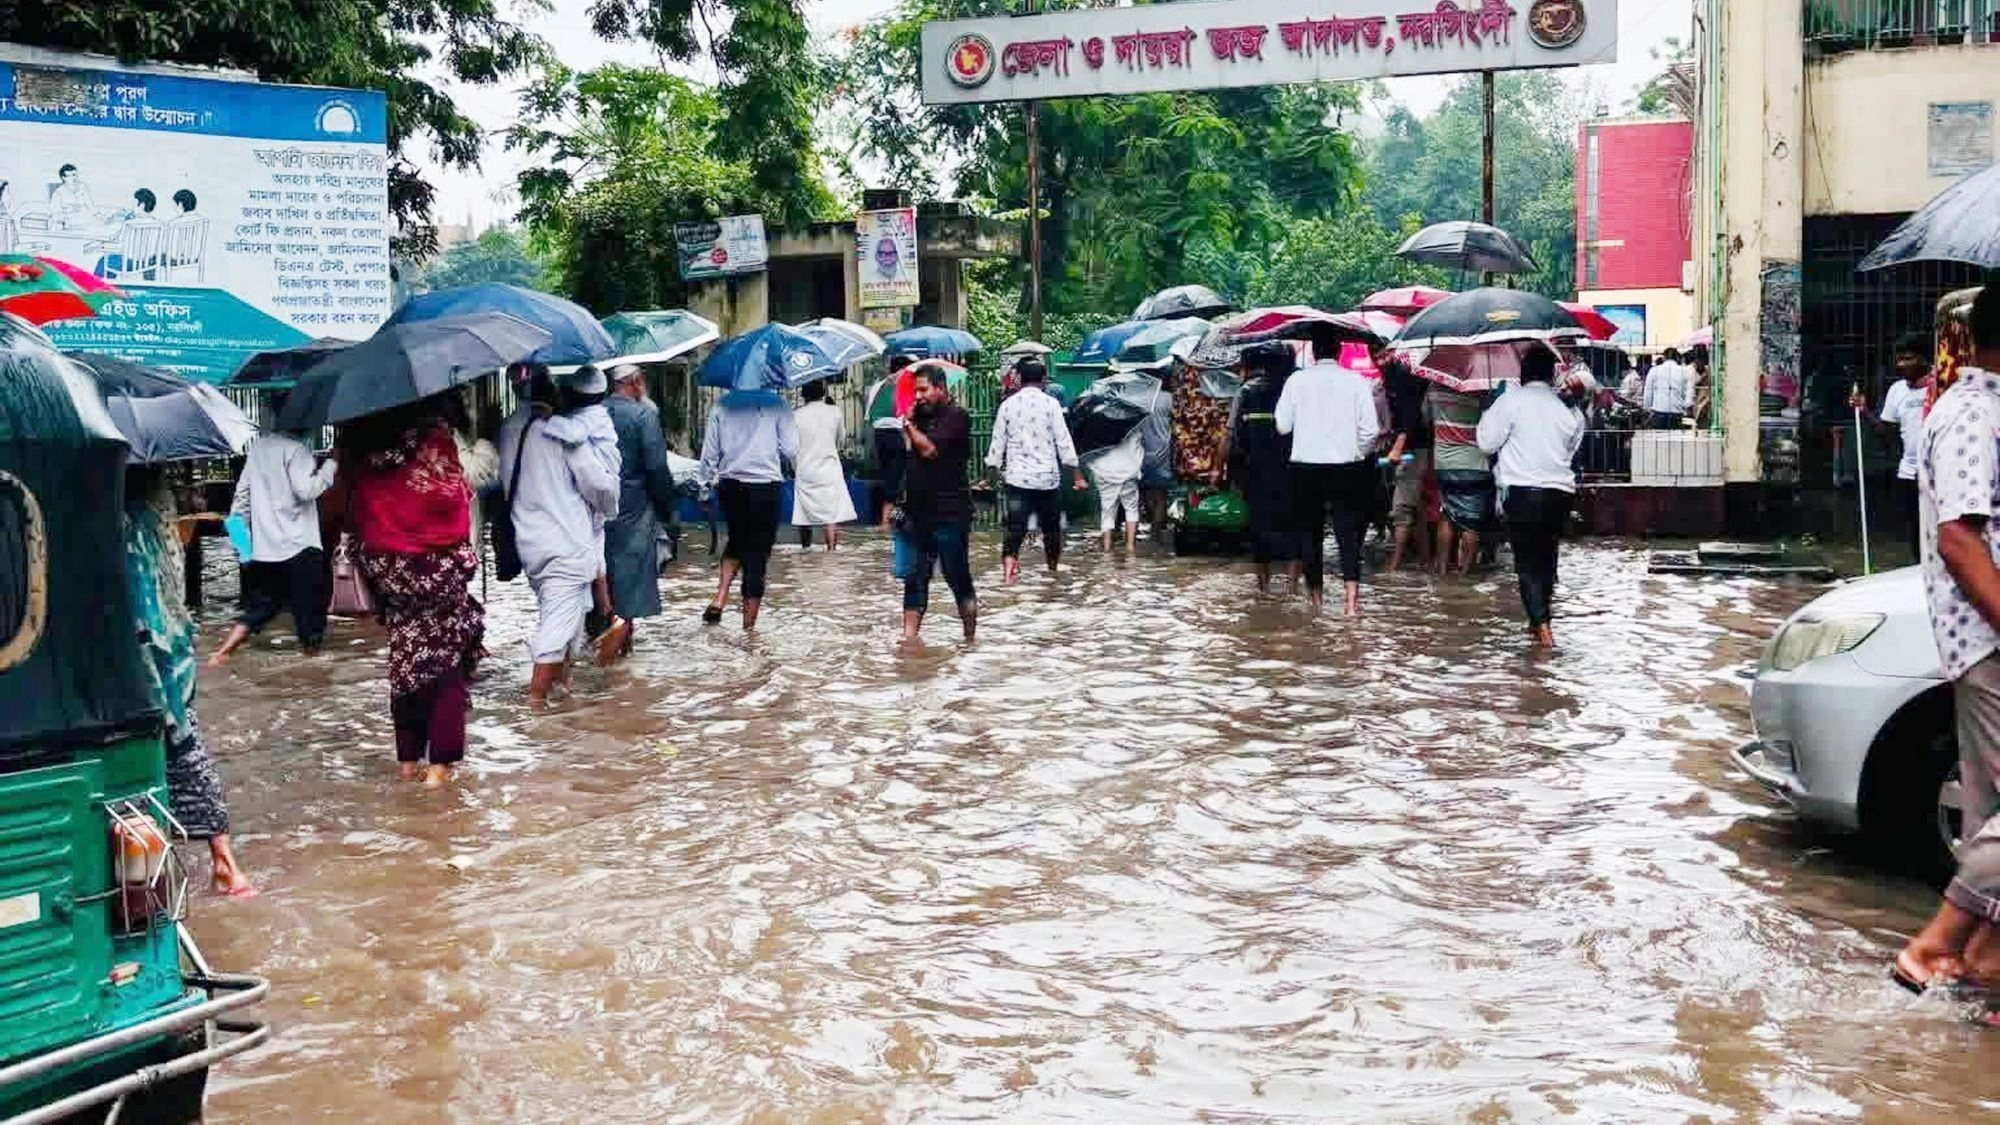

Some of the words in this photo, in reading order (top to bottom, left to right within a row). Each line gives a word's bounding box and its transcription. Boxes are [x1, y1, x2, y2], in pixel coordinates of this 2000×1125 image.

[1002, 35, 1074, 78] জেলা
[1082, 36, 1105, 70] ও
[1111, 25, 1198, 72] দায়রা
[1206, 25, 1270, 63] জজ
[1277, 14, 1396, 57] আদালত,
[1396, 0, 1517, 51] নরসিংদী
[116, 85, 147, 104] পূরণ
[142, 105, 197, 126] উন্মোচন
[249, 190, 282, 203] মামলা
[322, 192, 331, 203] ও
[335, 190, 385, 205] পরিচালনা
[241, 206, 272, 220] জবাব
[275, 204, 309, 220] দাখিল
[313, 209, 323, 220] ও
[235, 222, 262, 237] কোর্ট
[265, 222, 280, 237] ফি
[321, 227, 348, 239] নকল
[224, 238, 272, 254] জামিনের
[274, 258, 315, 272] ডিএনএ
[353, 262, 386, 273] পেপার
[333, 278, 360, 290] সকল
[99, 301, 140, 320] এইড
[143, 300, 192, 320] অফিস
[291, 313, 327, 325] সরকার
[332, 313, 356, 325] বহন
